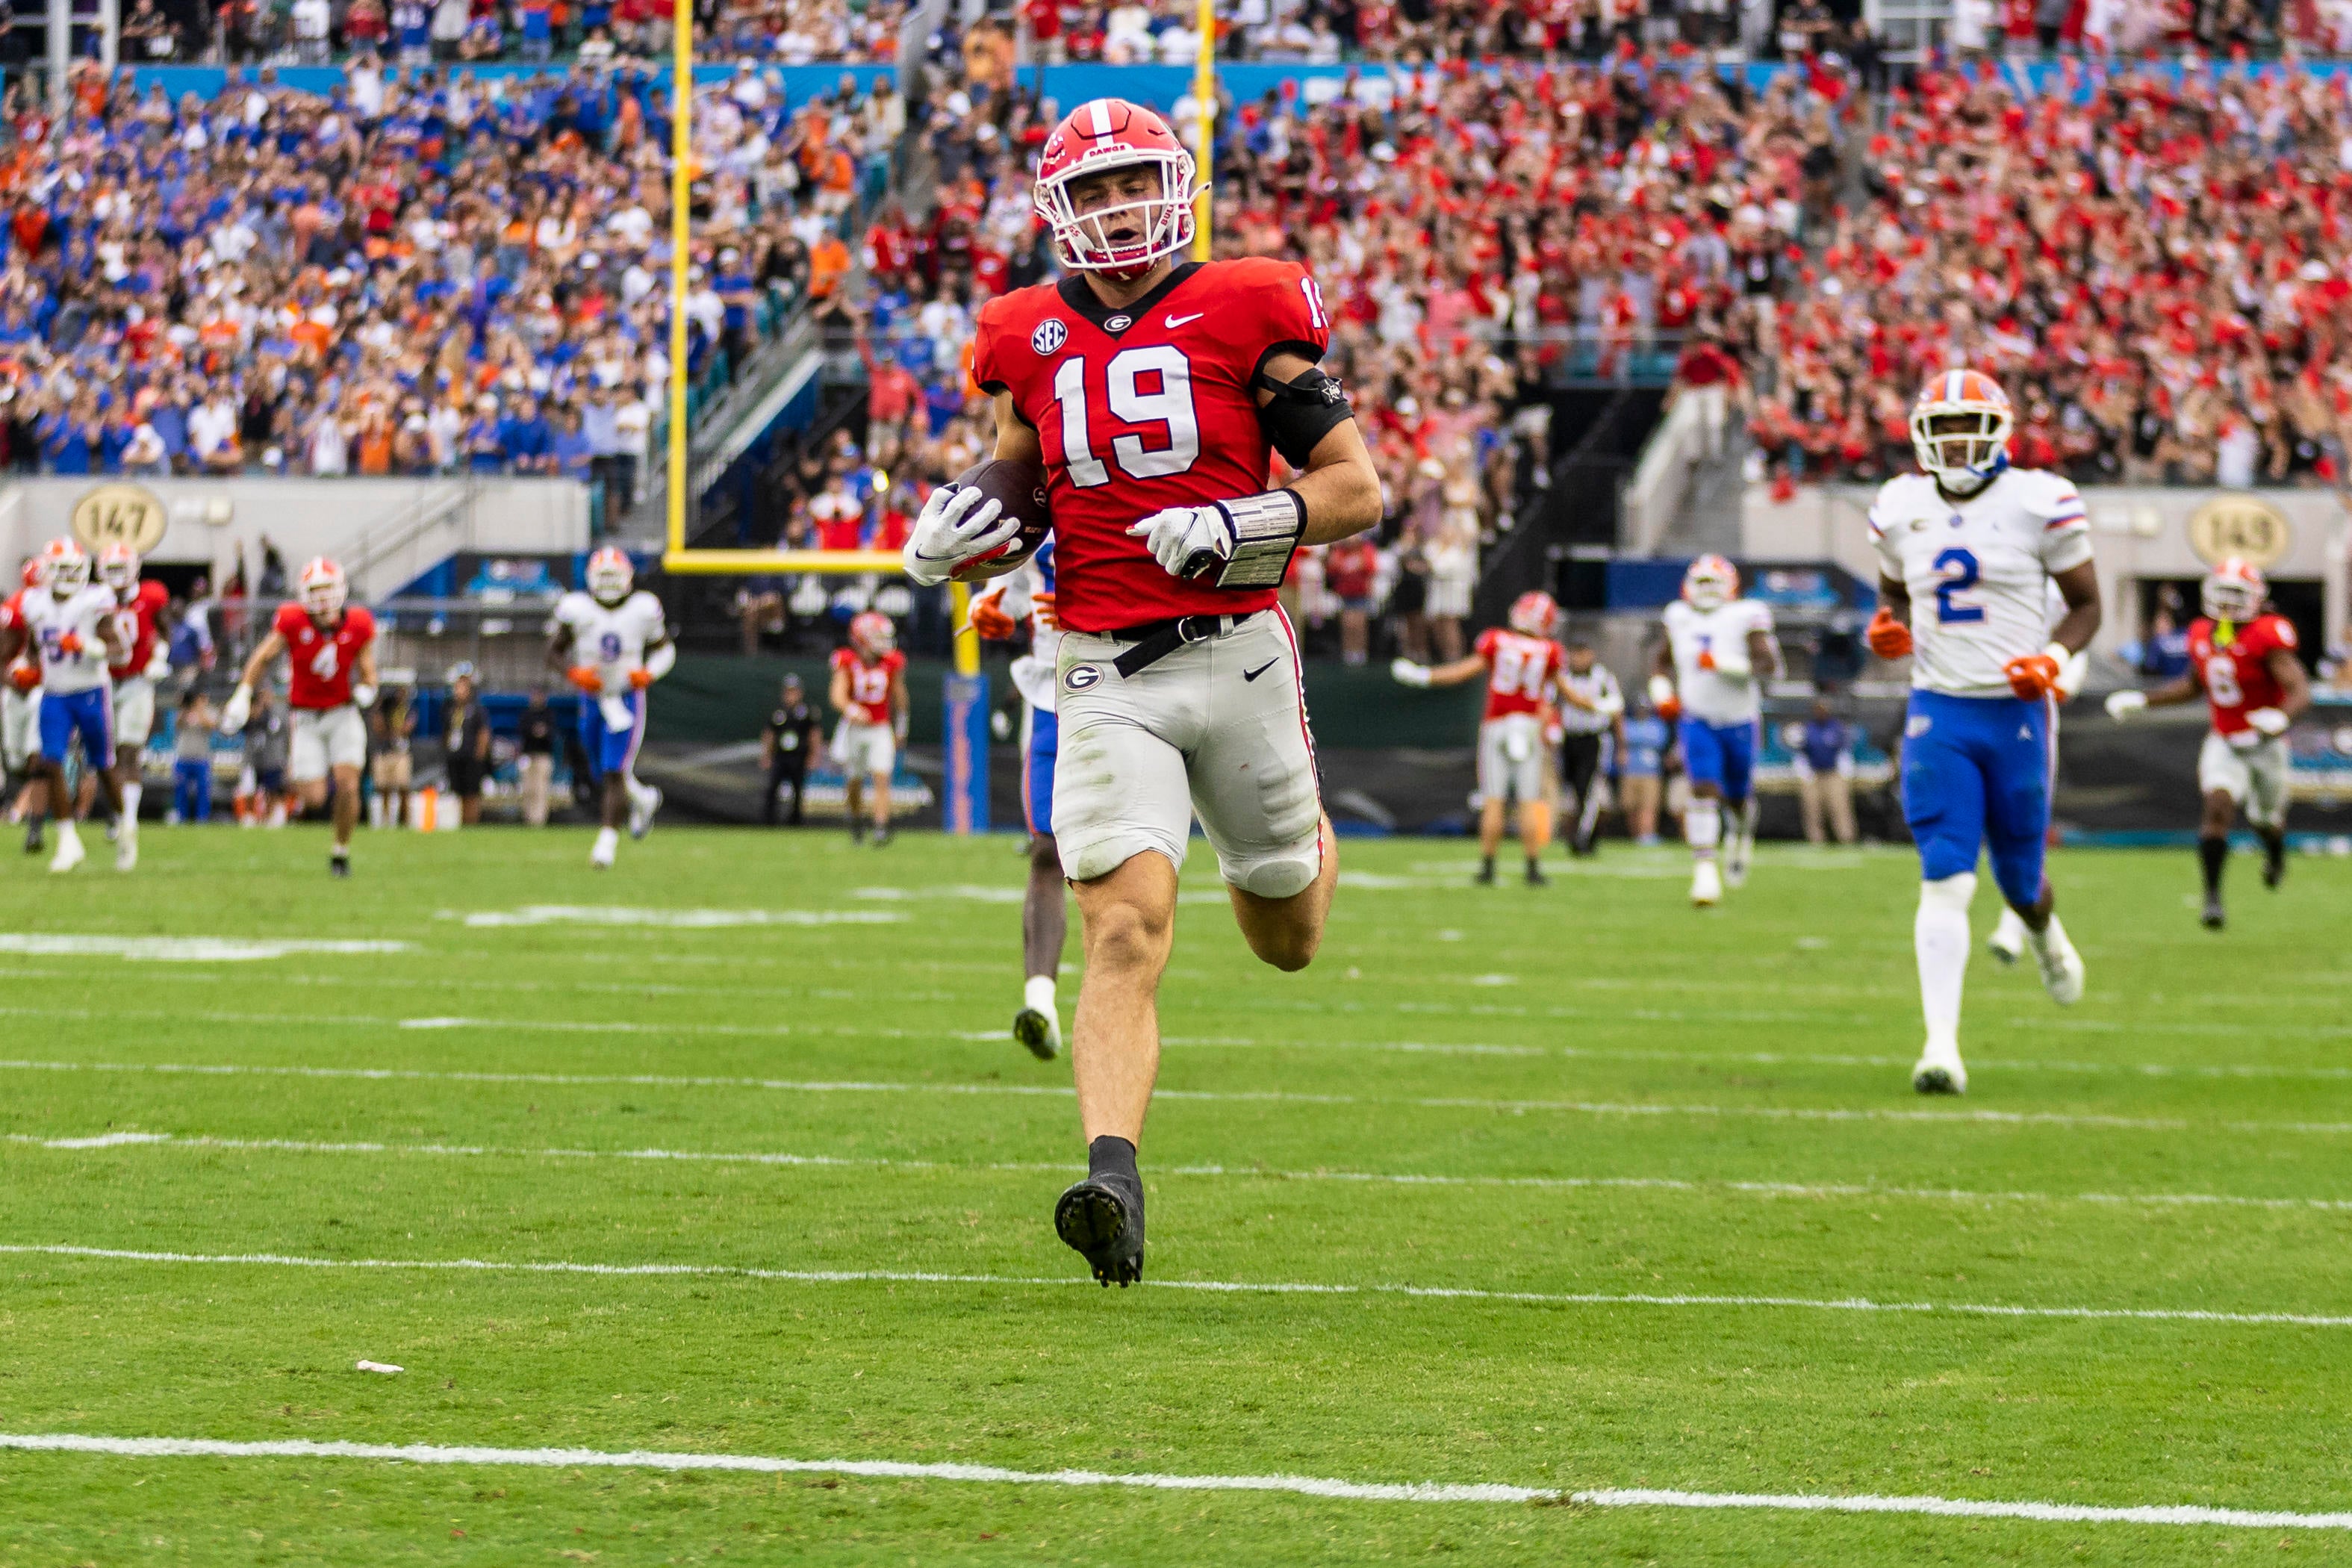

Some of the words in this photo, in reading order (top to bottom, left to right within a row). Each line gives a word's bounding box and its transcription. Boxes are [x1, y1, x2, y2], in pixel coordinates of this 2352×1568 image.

[1089, 145, 1126, 157] DAWGS
[1033, 320, 1065, 353] SEC
[1054, 344, 1200, 488] 19
[90, 503, 146, 538] 147
[1931, 546, 1985, 624] 2
[311, 642, 339, 682] 4
[600, 632, 621, 663] 9
